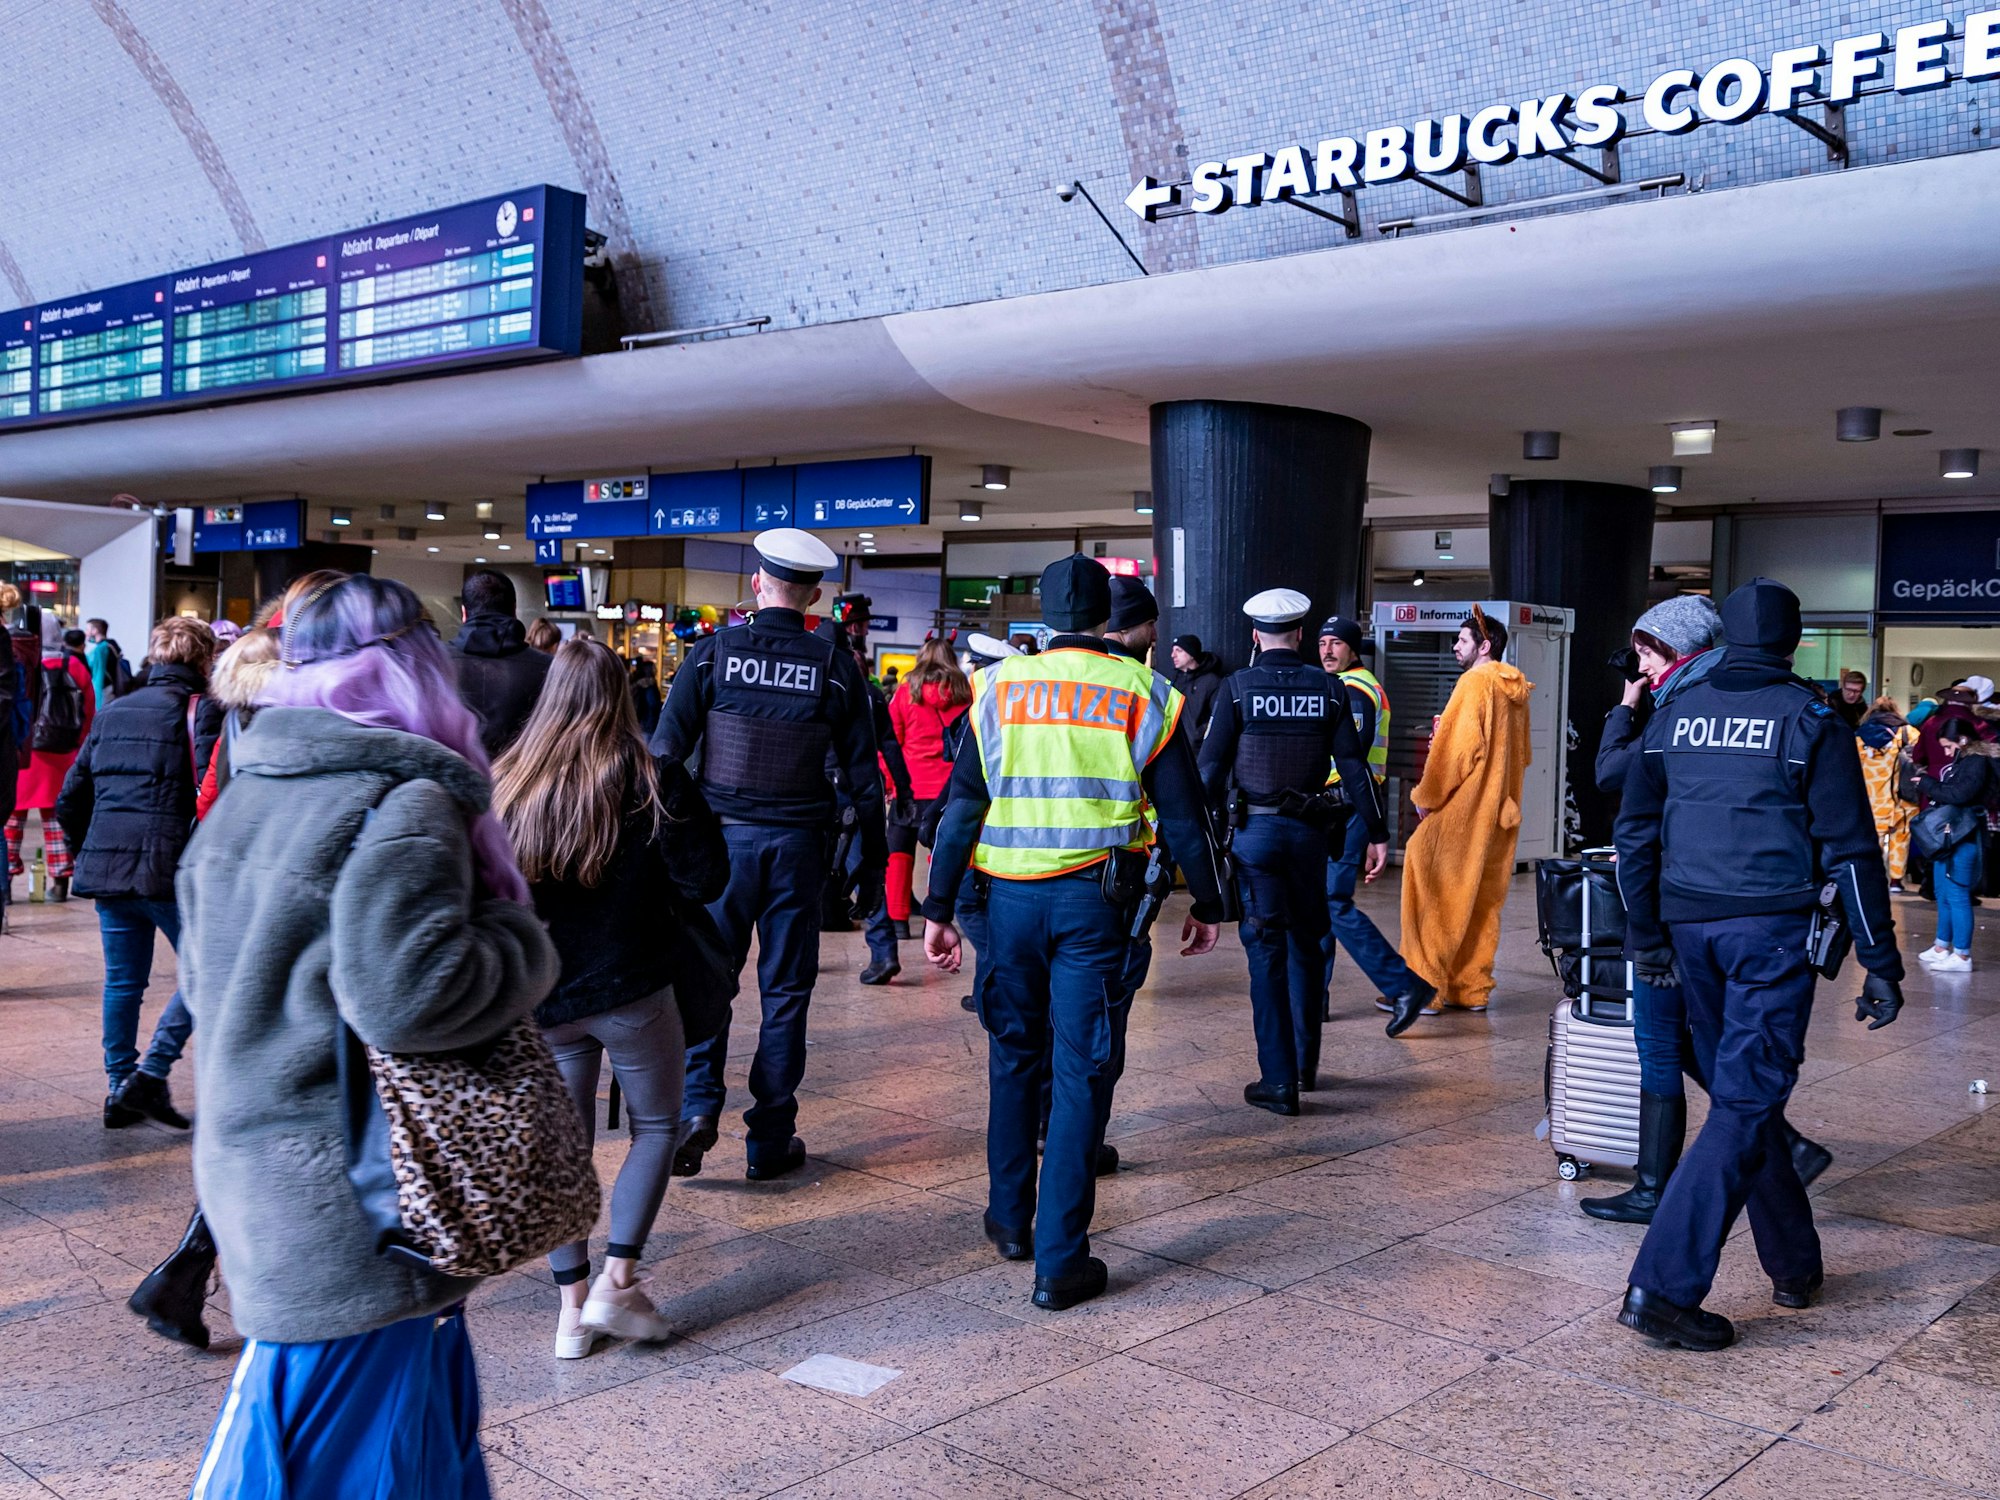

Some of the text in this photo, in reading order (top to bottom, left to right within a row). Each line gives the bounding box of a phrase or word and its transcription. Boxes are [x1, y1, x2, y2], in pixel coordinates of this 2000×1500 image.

[1190, 9, 2000, 213] STARBUCKS COFFEE
[341, 236, 373, 258] Abfahrt
[846, 498, 894, 510] GepäckCenter
[1398, 608, 1477, 620] DB Informati
[725, 656, 817, 691] POLIZEI
[1004, 680, 1138, 727] POLIZE
[1252, 695, 1324, 717] POLIZEI
[1672, 717, 1775, 750] POLIZEI
